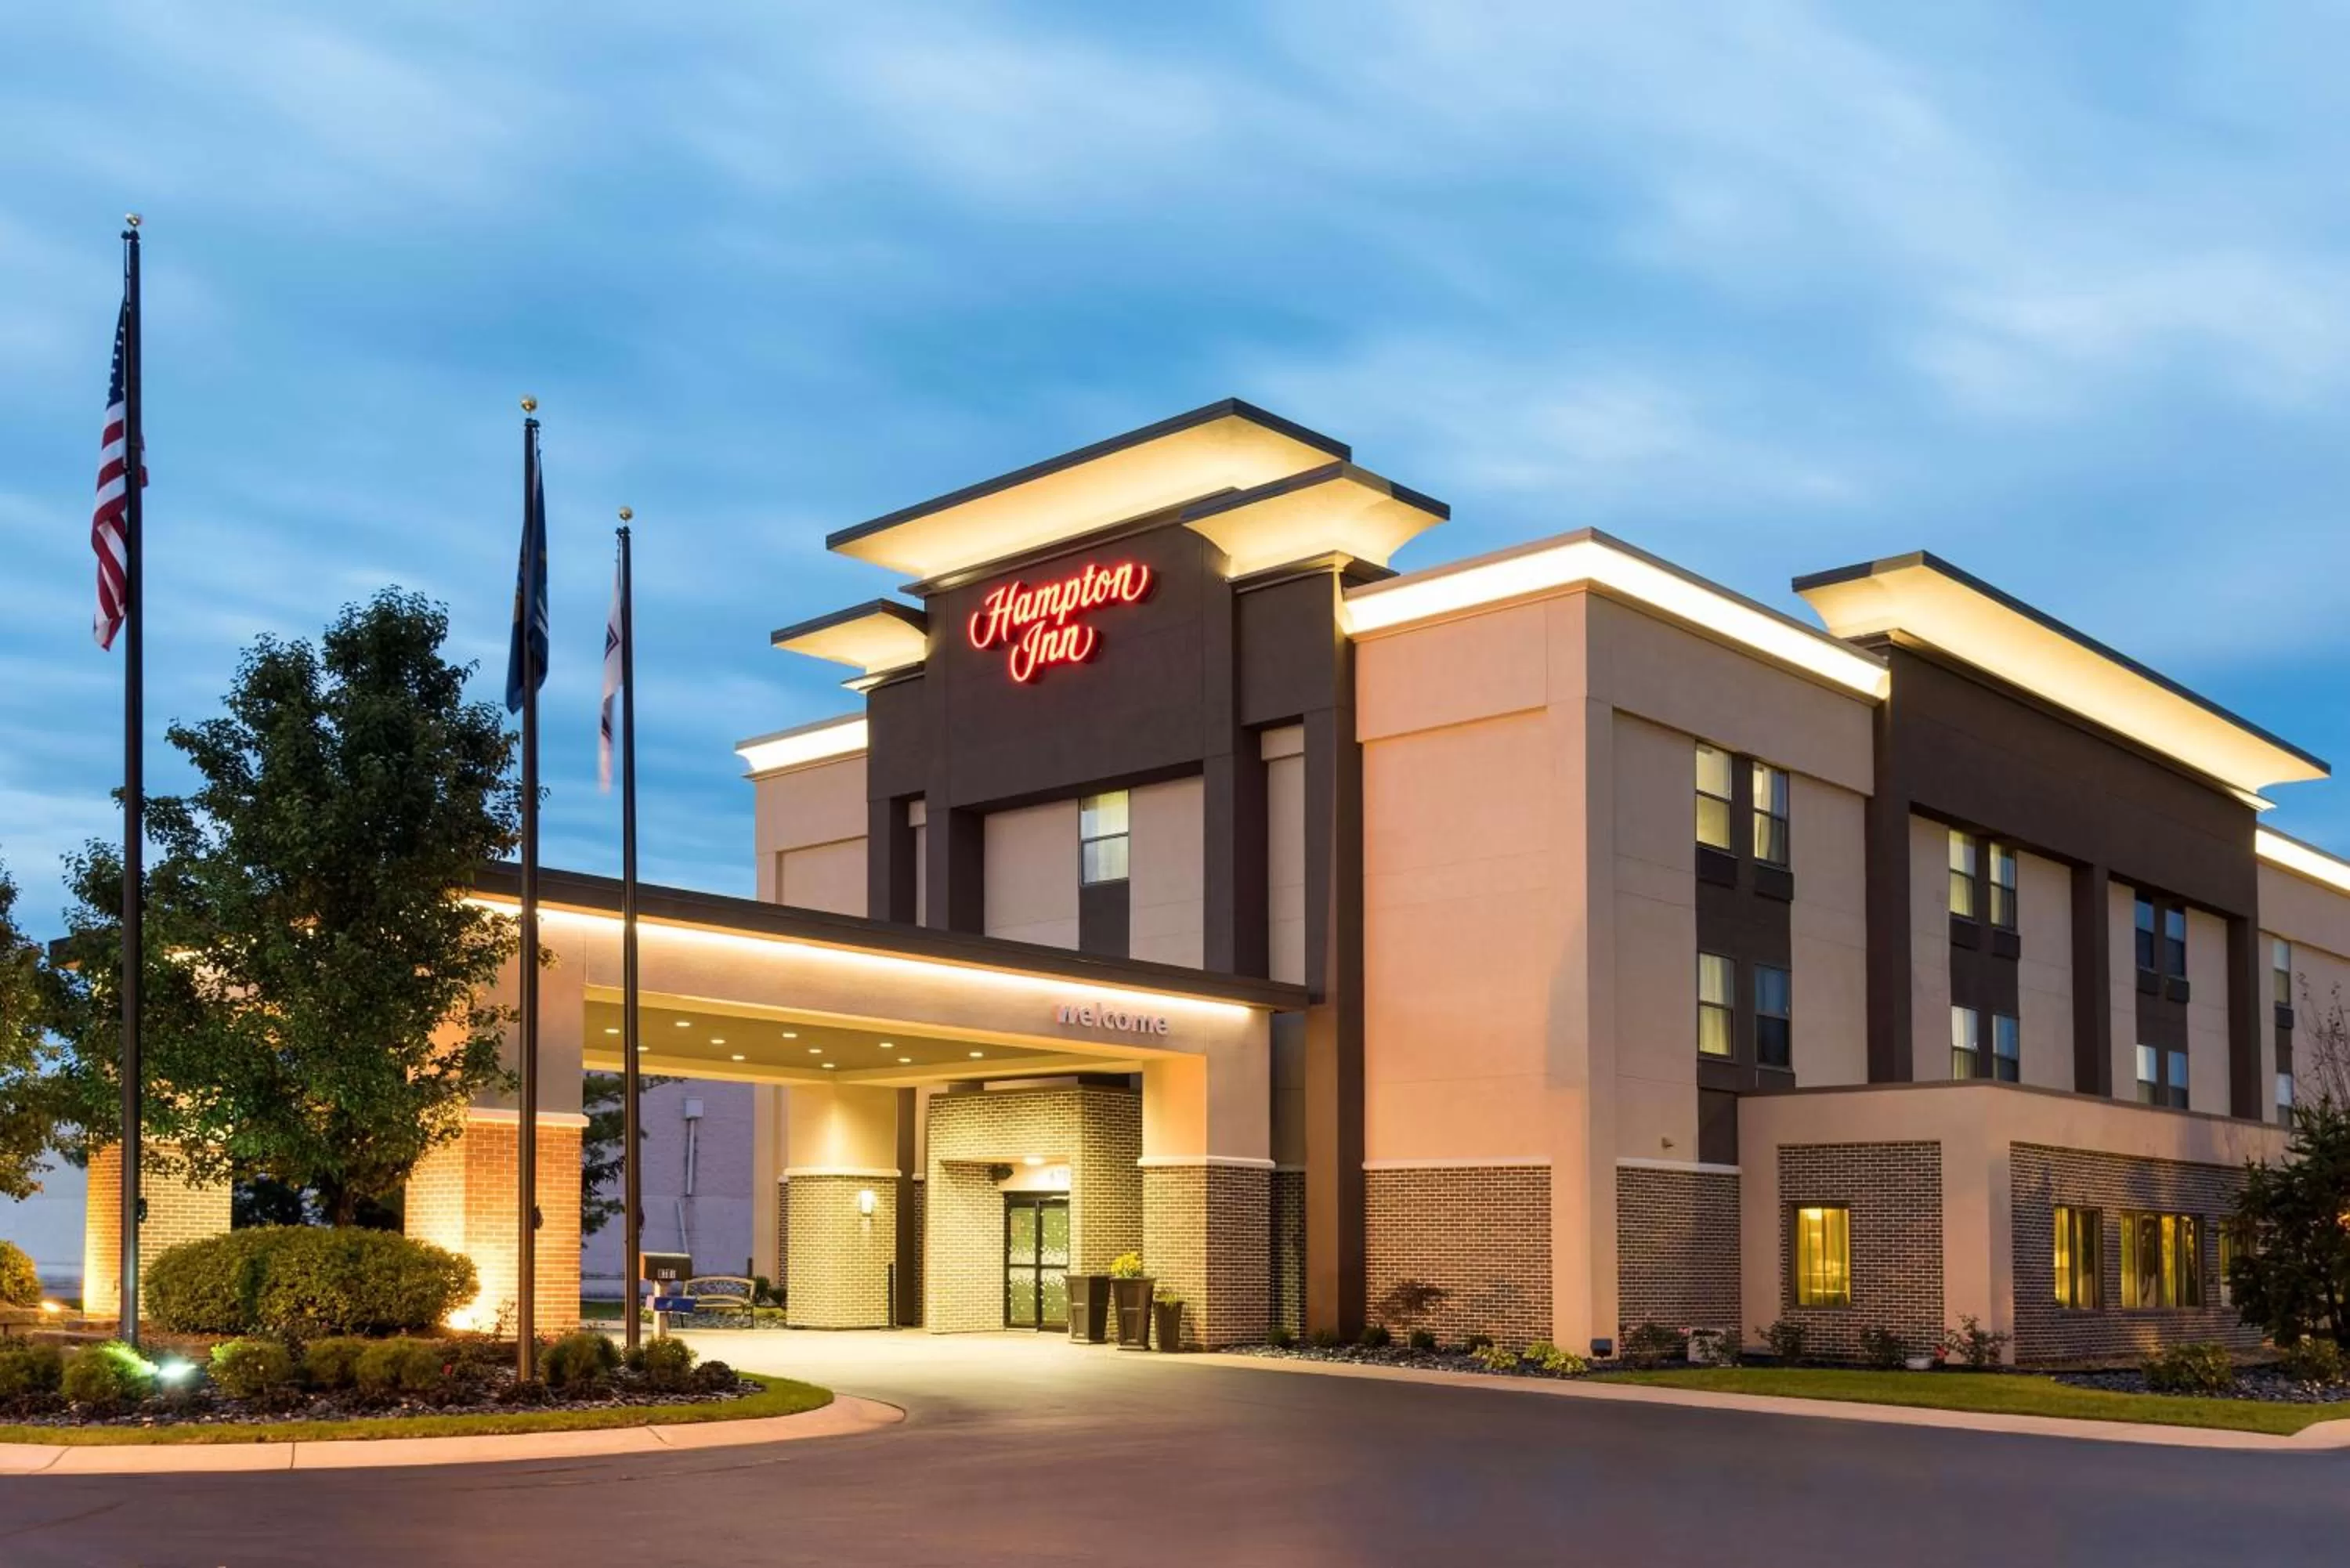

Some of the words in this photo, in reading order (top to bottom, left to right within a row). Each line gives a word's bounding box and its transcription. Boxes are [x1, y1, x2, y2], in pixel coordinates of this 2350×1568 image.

[969, 562, 1148, 649] Hampton
[1010, 620, 1094, 682] Inn
[1056, 1002, 1170, 1035] welcome
